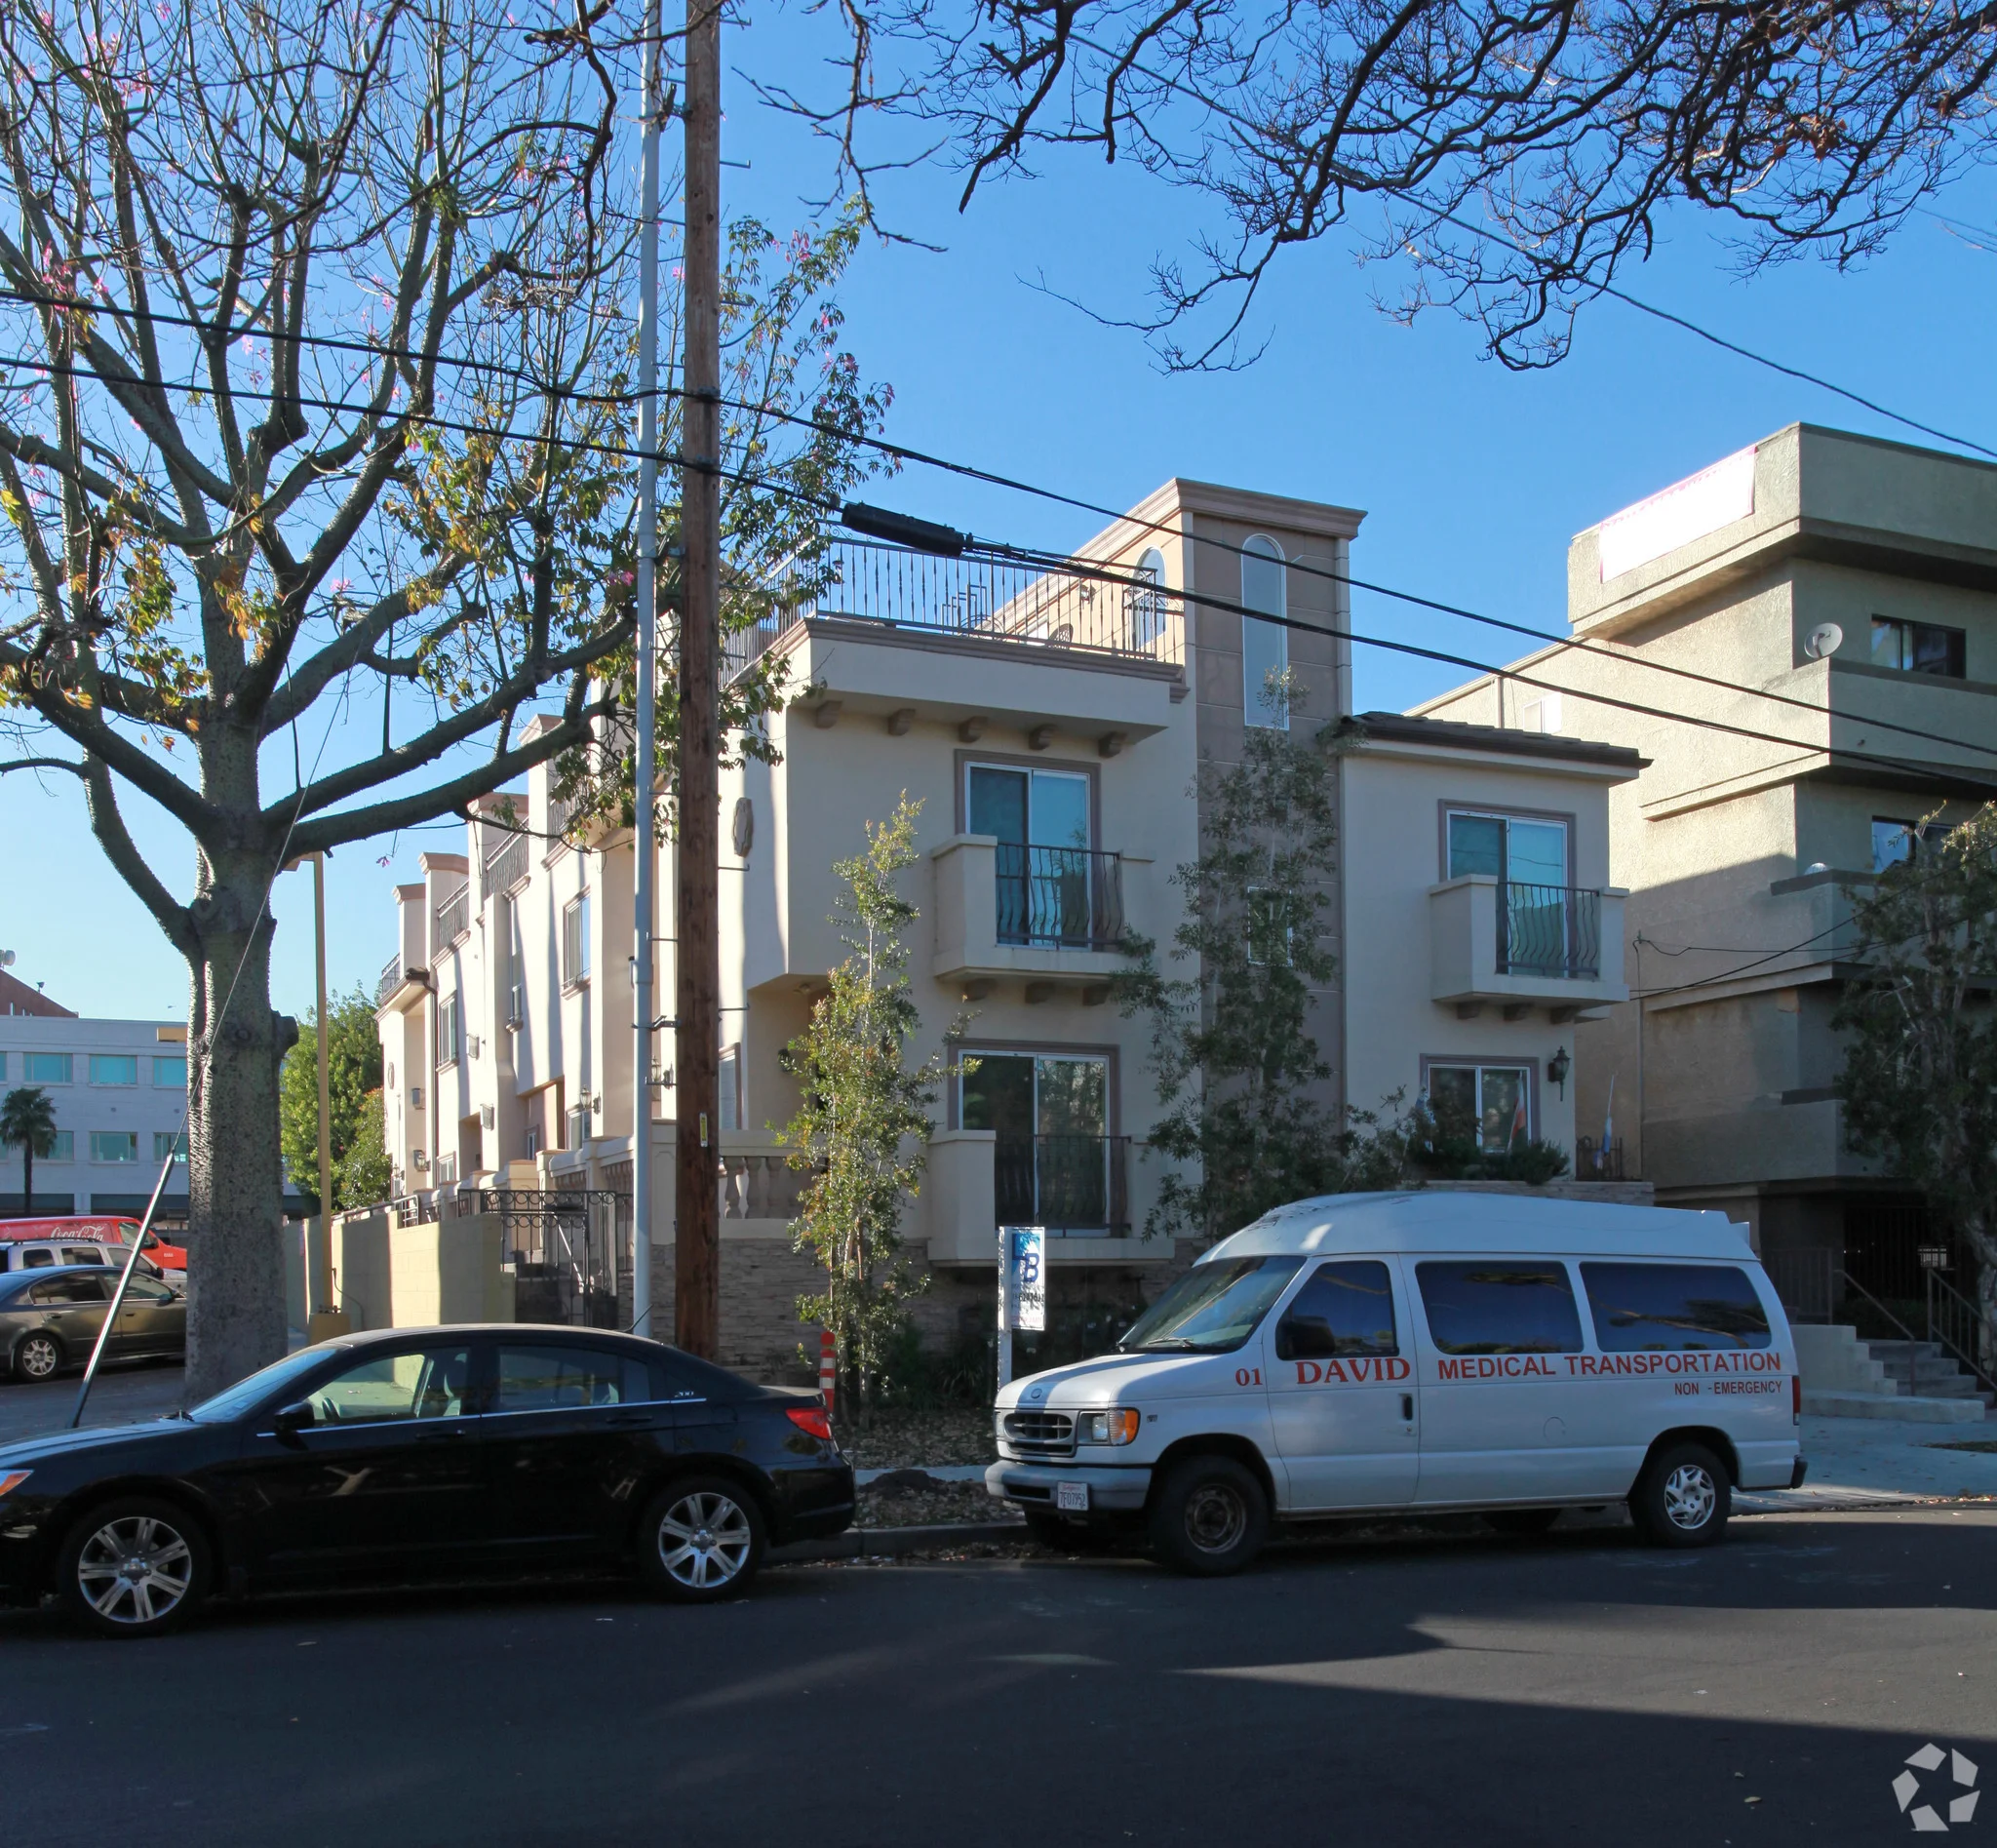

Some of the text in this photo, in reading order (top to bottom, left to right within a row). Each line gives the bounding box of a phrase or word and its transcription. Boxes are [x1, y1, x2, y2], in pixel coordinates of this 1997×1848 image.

[1234, 1368, 1263, 1386] 01
[1297, 1353, 1782, 1384] DAVID MEDICAL TRANSPORTATION
[1674, 1382, 1700, 1396] NON
